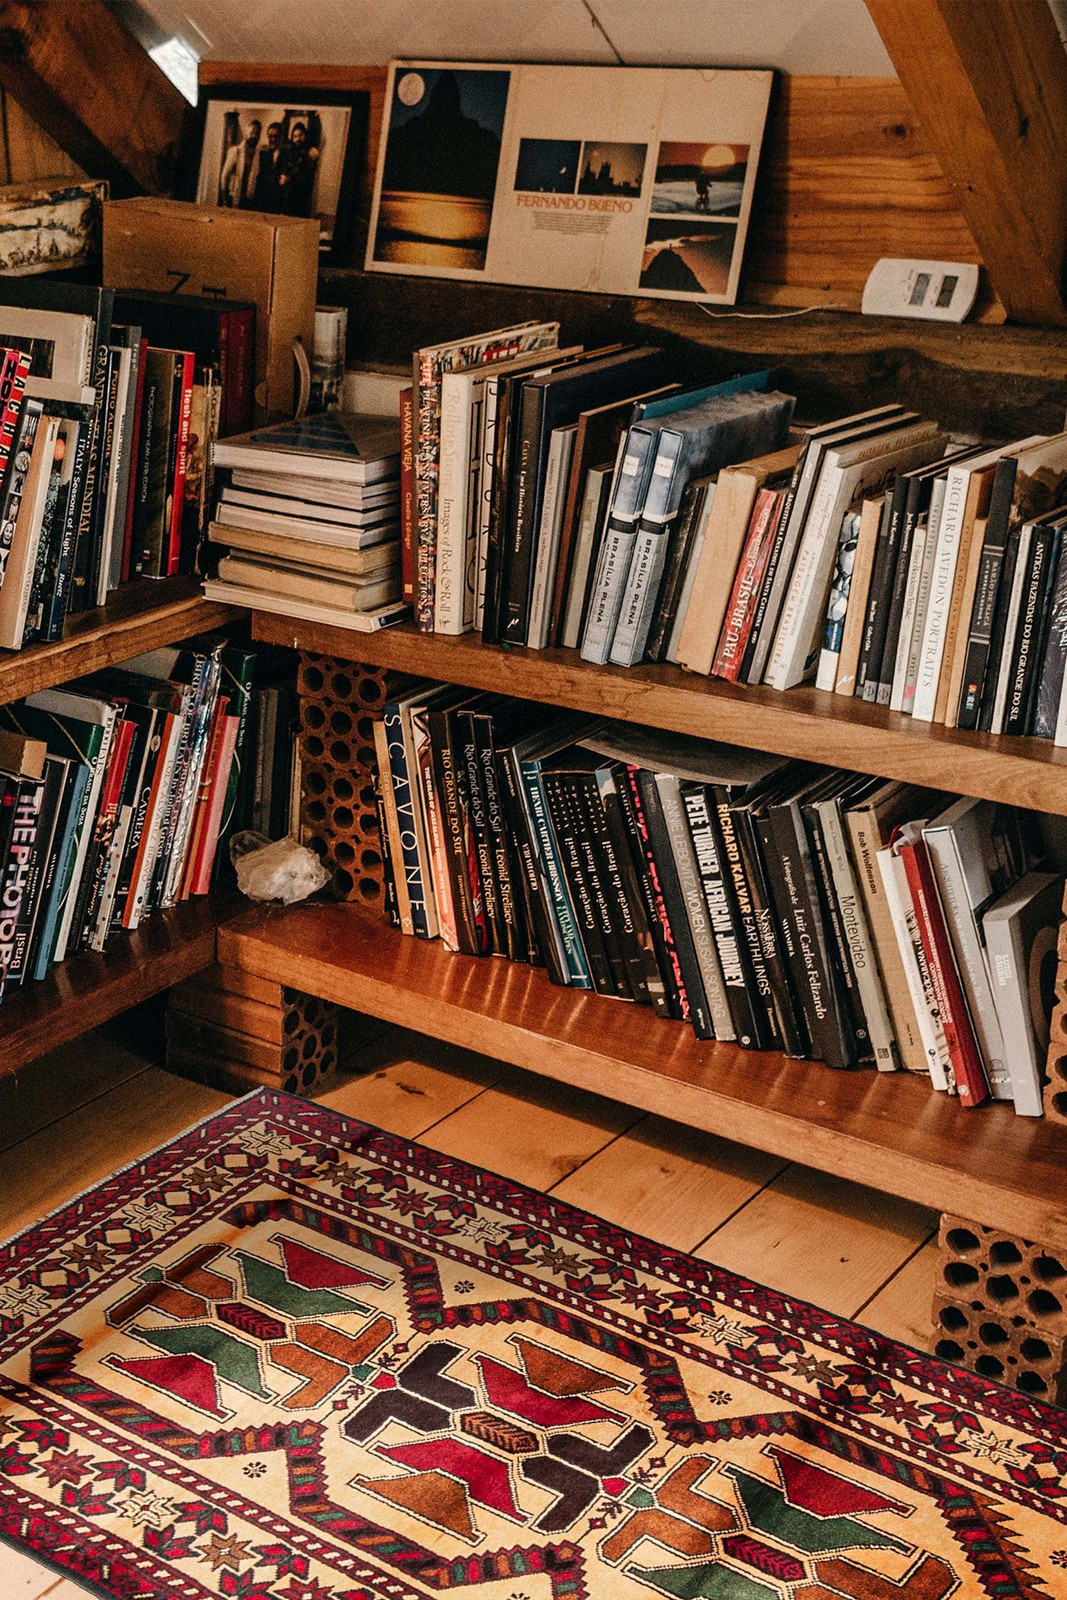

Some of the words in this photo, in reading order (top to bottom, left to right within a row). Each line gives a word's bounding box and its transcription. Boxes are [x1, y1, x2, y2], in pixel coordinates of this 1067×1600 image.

[516, 194, 587, 210] FERNANDO
[588, 199, 633, 214] BUENO
[108, 369, 119, 409] PORTO
[421, 361, 431, 384] LIFE
[181, 387, 193, 418] flesh
[104, 411, 114, 458] ALEGRE
[180, 419, 190, 442] and
[403, 401, 412, 445] HAVANA
[421, 390, 430, 450] PLATINUM
[72, 438, 87, 475] ITALY:
[176, 444, 188, 475] spirit
[403, 447, 412, 472] VIEJA
[66, 476, 80, 515] Seasons
[78, 465, 95, 536] MUNDIAL
[404, 492, 412, 520] Claudio
[420, 454, 430, 533] ANNIVERSARY
[516, 488, 525, 517] História
[942, 475, 962, 544] RICHARD
[64, 516, 74, 528] of
[441, 497, 454, 535] Images
[777, 492, 794, 536] ARQUITETURA
[59, 530, 72, 557] Light
[403, 522, 412, 550] Edinger
[440, 537, 453, 547] of
[514, 518, 523, 552] Brasileira
[769, 535, 783, 567] ENXAIMEL
[418, 537, 428, 608] COLLECTION
[440, 548, 452, 575] Rock
[603, 536, 620, 588] BRASÍLIA
[633, 537, 653, 590] BRASÍLIA
[767, 566, 775, 576] EM
[789, 549, 809, 602] PAISAGEM
[934, 547, 951, 606] AVEDON
[987, 560, 1000, 590] BARÃO
[1030, 541, 1045, 580] ANTIGAS
[440, 575, 450, 590] &
[761, 576, 772, 597] SANTA
[985, 590, 993, 602] DE
[438, 590, 451, 612] Roll
[595, 590, 608, 624] PLENA
[626, 592, 639, 626] PLENA
[720, 574, 756, 659] PAU-BRASIL
[753, 596, 767, 627] CATARINA
[1024, 580, 1039, 624] FAZENDAS
[772, 606, 794, 665] BRASILEIRA
[1019, 638, 1029, 654] RIO
[1022, 623, 1032, 638] DO
[921, 609, 942, 688] PORTRAITS
[188, 659, 203, 699] BIRDS
[244, 681, 252, 690] O
[1013, 654, 1027, 691] GRANDE
[184, 705, 194, 719] OF
[1009, 705, 1019, 722] SUL
[1011, 691, 1021, 706] DO
[172, 722, 190, 775] BRITAIN
[236, 728, 245, 746] SOJA
[464, 743, 476, 760] Rio
[159, 759, 174, 788] LOLA
[441, 748, 452, 768] RIO
[481, 748, 493, 765] Rio
[168, 777, 179, 791] by
[171, 760, 194, 803] PRIMAL
[425, 779, 433, 800] COLOR
[443, 769, 457, 814] GRANDE
[466, 761, 480, 795] Grande
[483, 766, 497, 800] Grande
[131, 786, 152, 850] CAMERA
[163, 790, 176, 816] John
[384, 713, 425, 911] SCAVONE
[428, 800, 435, 809] OF
[429, 809, 437, 825] JAZZ
[471, 809, 485, 828] Sul
[472, 796, 482, 810] do
[489, 801, 500, 815] do
[529, 786, 544, 818] HENRI
[664, 798, 683, 833] ANNIE
[683, 792, 710, 827] PETE
[431, 825, 440, 847] ALBUM
[449, 817, 459, 834] DO
[488, 814, 502, 833] Sul
[536, 818, 553, 860] CARTIER
[856, 830, 867, 848] Bob
[154, 825, 169, 858] Green
[451, 835, 463, 855] SUL
[563, 835, 580, 869] Brasil
[580, 840, 597, 872] Brasil
[601, 839, 617, 872] Brasil
[690, 825, 721, 876] TURNER
[780, 854, 789, 862] A
[138, 844, 155, 882] BRAVO
[478, 843, 491, 876] Leonid
[494, 848, 508, 881] Leonid
[672, 833, 696, 889] LEIBOVITZ
[859, 848, 879, 895] Wolfenson
[82, 879, 101, 916] Estrada
[92, 853, 107, 880] Real
[457, 874, 465, 895] LEONID
[546, 860, 563, 903] BRESSON
[573, 870, 583, 884] do
[590, 874, 600, 889] do
[610, 873, 622, 888] do
[780, 861, 798, 896] Fotografia
[482, 877, 497, 919] Streliaev
[499, 882, 514, 924] Streliaev
[576, 885, 595, 929] Coração
[593, 891, 612, 934] Coração
[612, 888, 633, 934] Coração
[685, 888, 707, 933] WOMEN
[703, 877, 735, 933] AFRICAN
[715, 802, 741, 862] RICHARD
[729, 862, 753, 915] KALVAR
[741, 915, 772, 997] EARTHLINGS
[790, 895, 799, 905] de
[555, 905, 572, 956] LANDSCAPES
[791, 907, 809, 933] Luiz
[841, 895, 866, 969] Montevideo
[10, 933, 27, 970] Brasil
[695, 933, 715, 972] SUSAN
[716, 931, 748, 990] JOURNEY
[797, 932, 817, 970] Carlos
[1001, 954, 1012, 978] LUIGI
[927, 961, 942, 1001] PANORÂMICO
[993, 953, 1007, 987] GHIRRI
[704, 972, 727, 1019] SONTAG
[806, 969, 830, 1020] Felizardo
[936, 1000, 948, 1024] SANTOS
